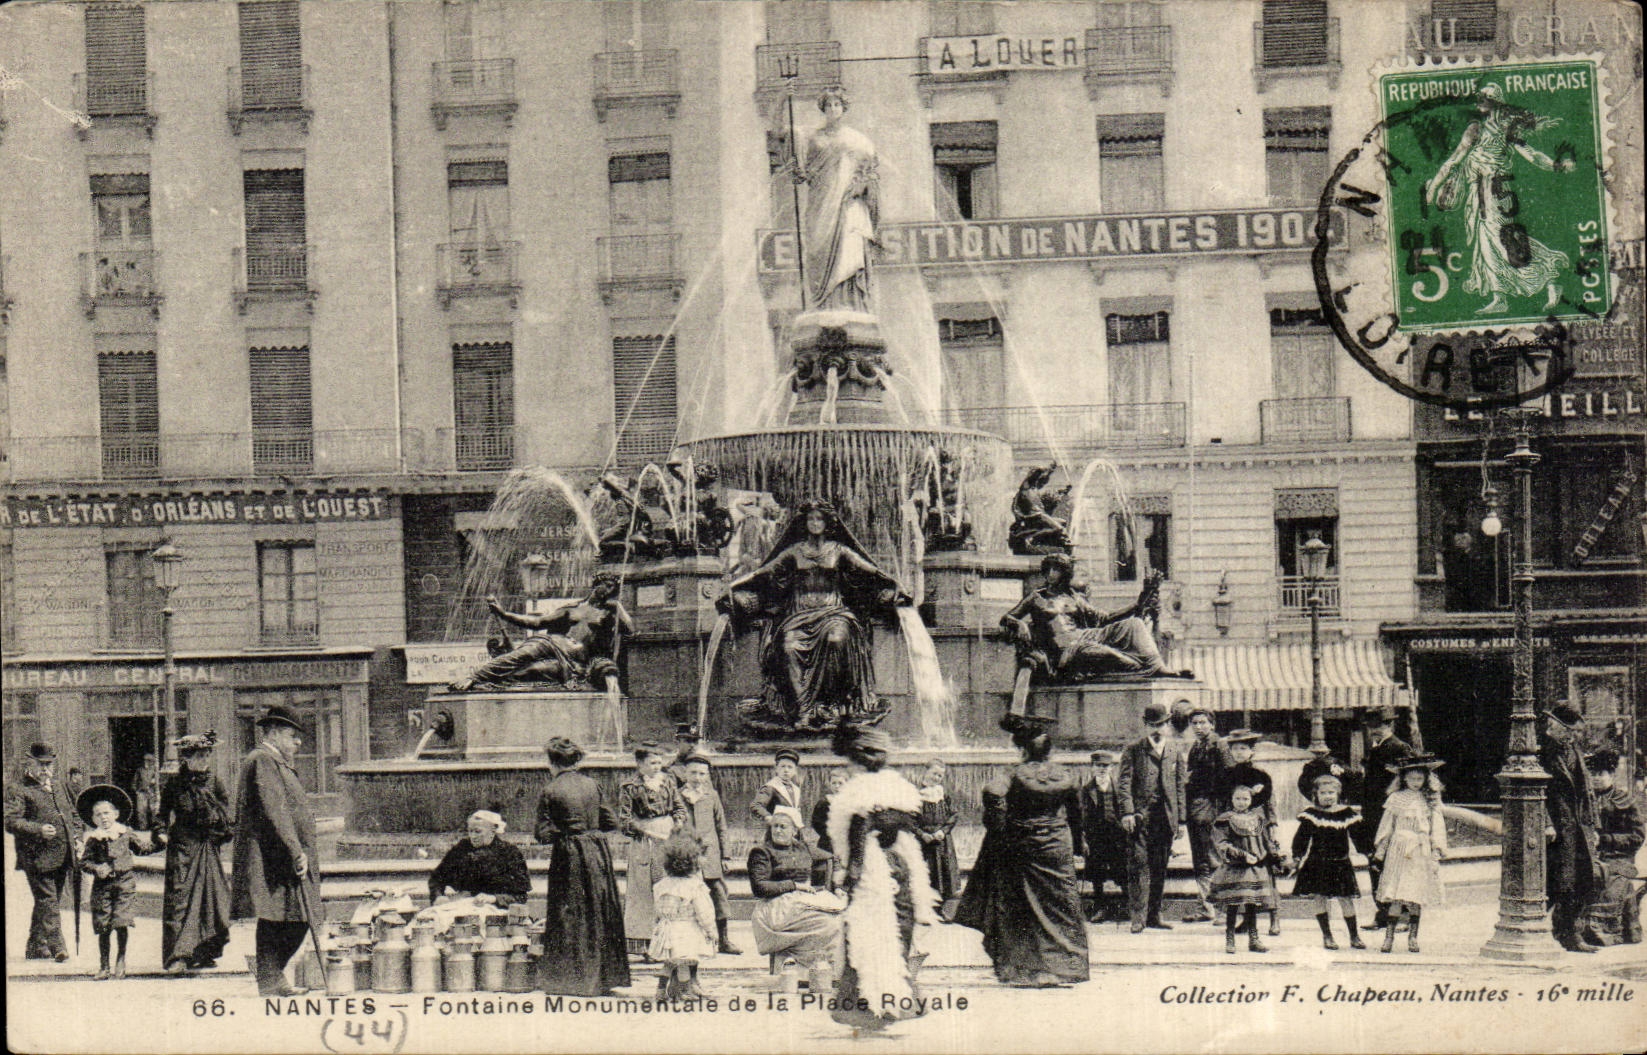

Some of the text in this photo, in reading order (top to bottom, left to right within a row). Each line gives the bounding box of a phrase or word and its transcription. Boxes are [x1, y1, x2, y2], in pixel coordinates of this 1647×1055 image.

[940, 37, 1078, 69] A LOUER
[1506, 70, 1588, 94] FRANÇAISE
[773, 223, 1011, 264] ESITION
[1021, 226, 1055, 256] DE
[1065, 215, 1218, 253] NANTES
[18, 509, 41, 525] DE
[244, 505, 265, 520] ET
[272, 504, 296, 519] DE
[302, 498, 382, 518] L'OUEST
[1410, 637, 1476, 648] COSTUMES
[4, 668, 87, 688] UREAU
